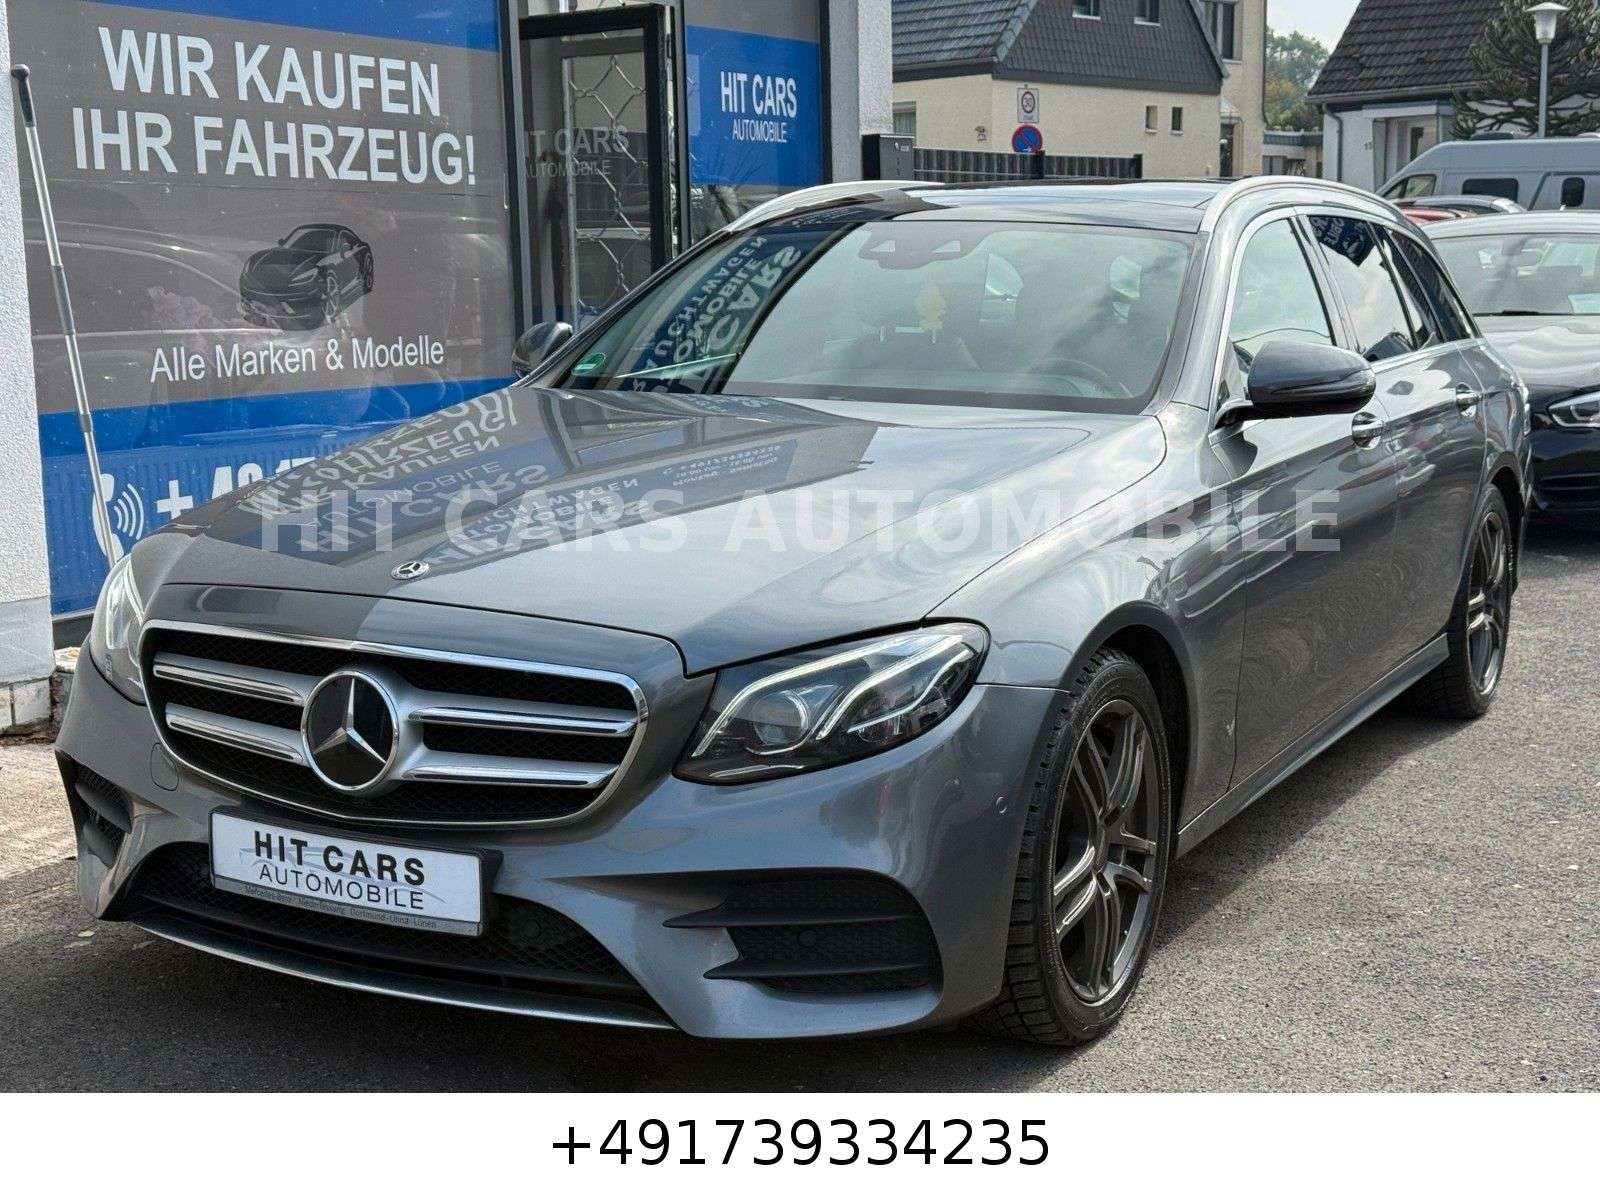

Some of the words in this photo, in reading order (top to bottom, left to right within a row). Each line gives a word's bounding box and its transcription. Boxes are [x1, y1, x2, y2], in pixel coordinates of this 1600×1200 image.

[98, 26, 219, 99] WIR
[234, 41, 441, 117] KAUFEN
[720, 70, 748, 114] HIT
[752, 74, 798, 118] CARS
[72, 107, 178, 174] IHR
[193, 116, 476, 185] FAHRZEUG!
[732, 118, 788, 144] AUTOMOBILE
[150, 346, 207, 384] Alle
[216, 341, 316, 378] Marken
[326, 338, 345, 372] &
[352, 335, 444, 370] Modelle
[254, 830, 308, 866] HIT
[323, 845, 425, 886] CARS
[260, 864, 424, 910] AUTOMOBILE
